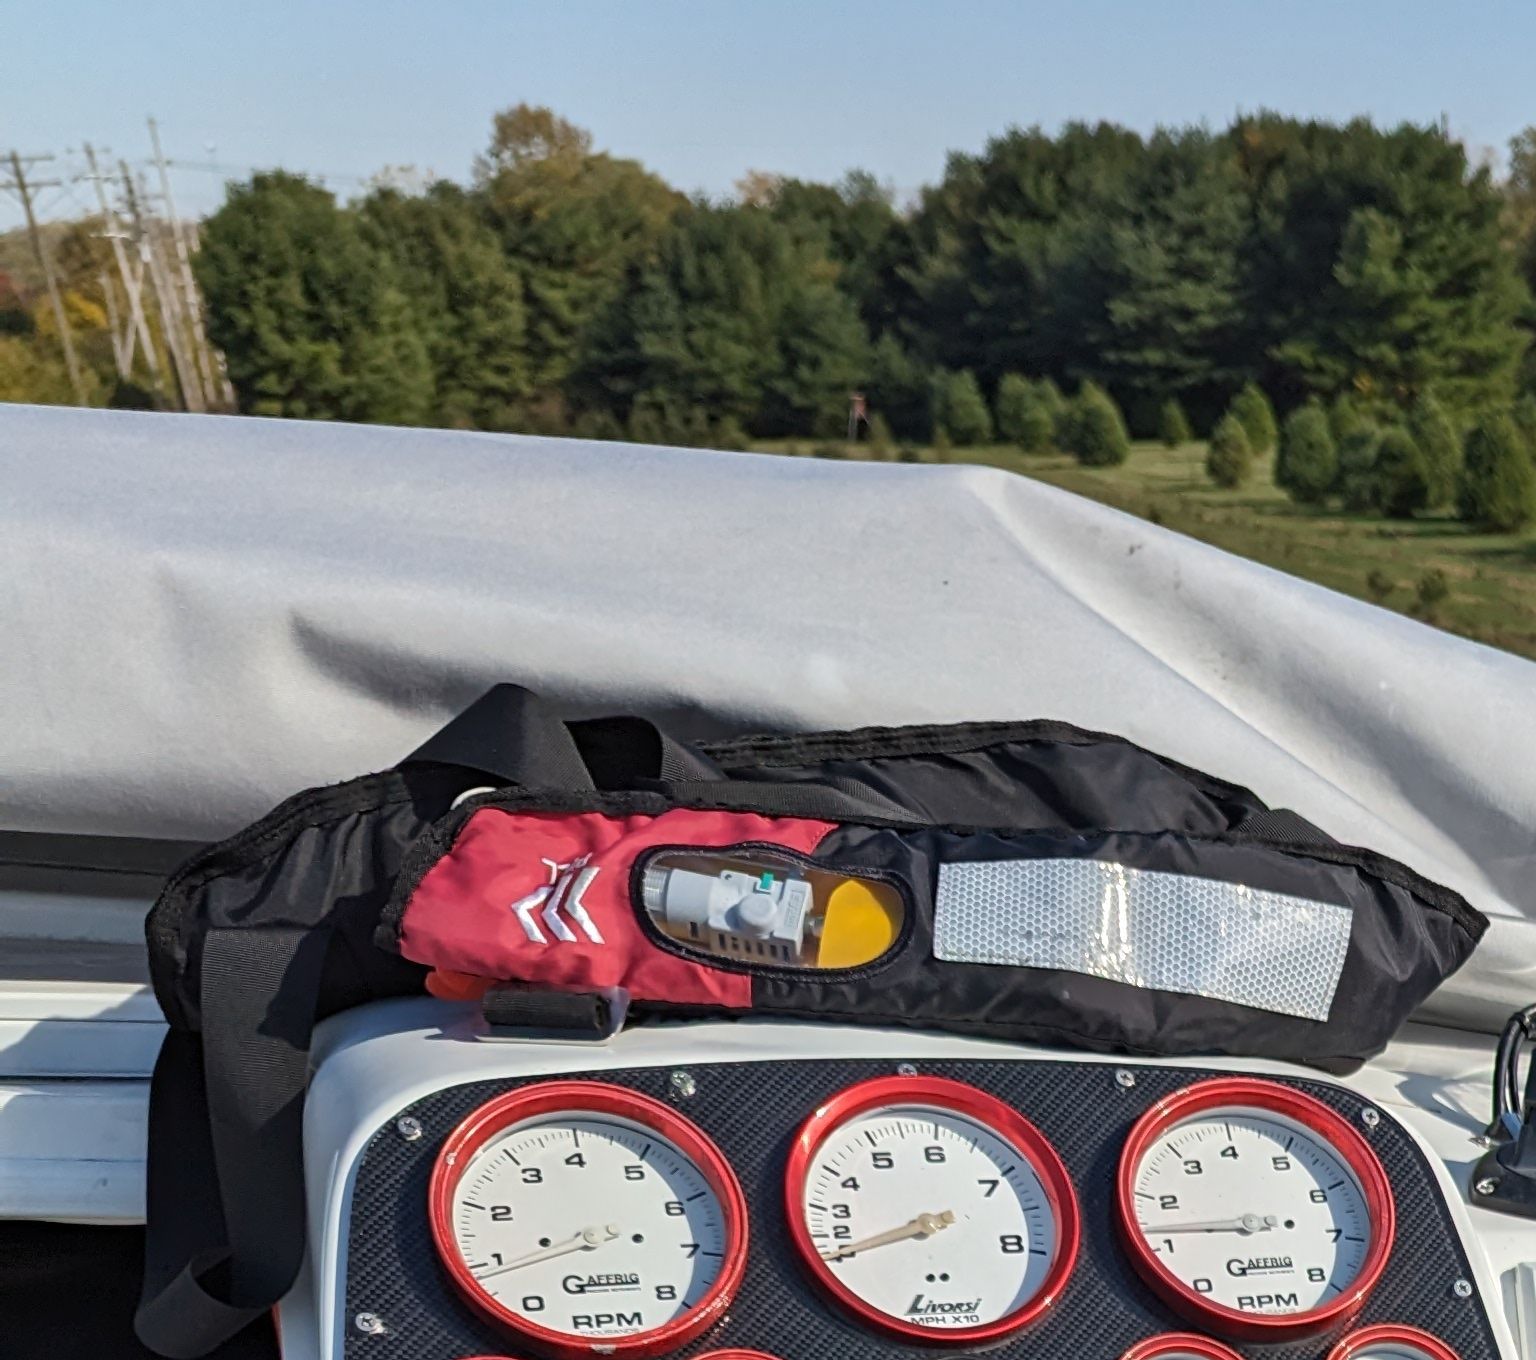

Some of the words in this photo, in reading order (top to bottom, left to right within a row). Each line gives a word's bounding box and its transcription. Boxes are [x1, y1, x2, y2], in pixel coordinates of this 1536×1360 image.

[565, 1153, 586, 1168] 4
[873, 1152, 894, 1169] 5
[925, 1147, 946, 1163] 6
[1220, 1146, 1239, 1160] 4
[1183, 1160, 1203, 1175] 3
[1272, 1157, 1290, 1171] 5
[522, 1168, 543, 1183] 3
[625, 1166, 645, 1180] 5
[841, 1177, 860, 1191] 4
[978, 1180, 999, 1197] 7
[1160, 1195, 1179, 1209] 2
[1309, 1189, 1328, 1203] 6
[491, 1206, 513, 1221] 2
[665, 1201, 686, 1216] 6
[832, 1204, 851, 1219] 3
[833, 1226, 852, 1240] 2
[1325, 1229, 1343, 1243] 7
[680, 1243, 700, 1258] 7
[999, 1235, 1024, 1253] 8
[1162, 1239, 1174, 1253] 1
[491, 1253, 503, 1266] 1
[1307, 1268, 1326, 1282] 8
[656, 1286, 677, 1300] 8
[1192, 1278, 1213, 1293] 0
[522, 1296, 545, 1312] 0
[1237, 1292, 1299, 1310] RPM
[572, 1312, 643, 1329] RPM
[909, 1315, 947, 1326] MPH
[952, 1315, 980, 1324] X10
